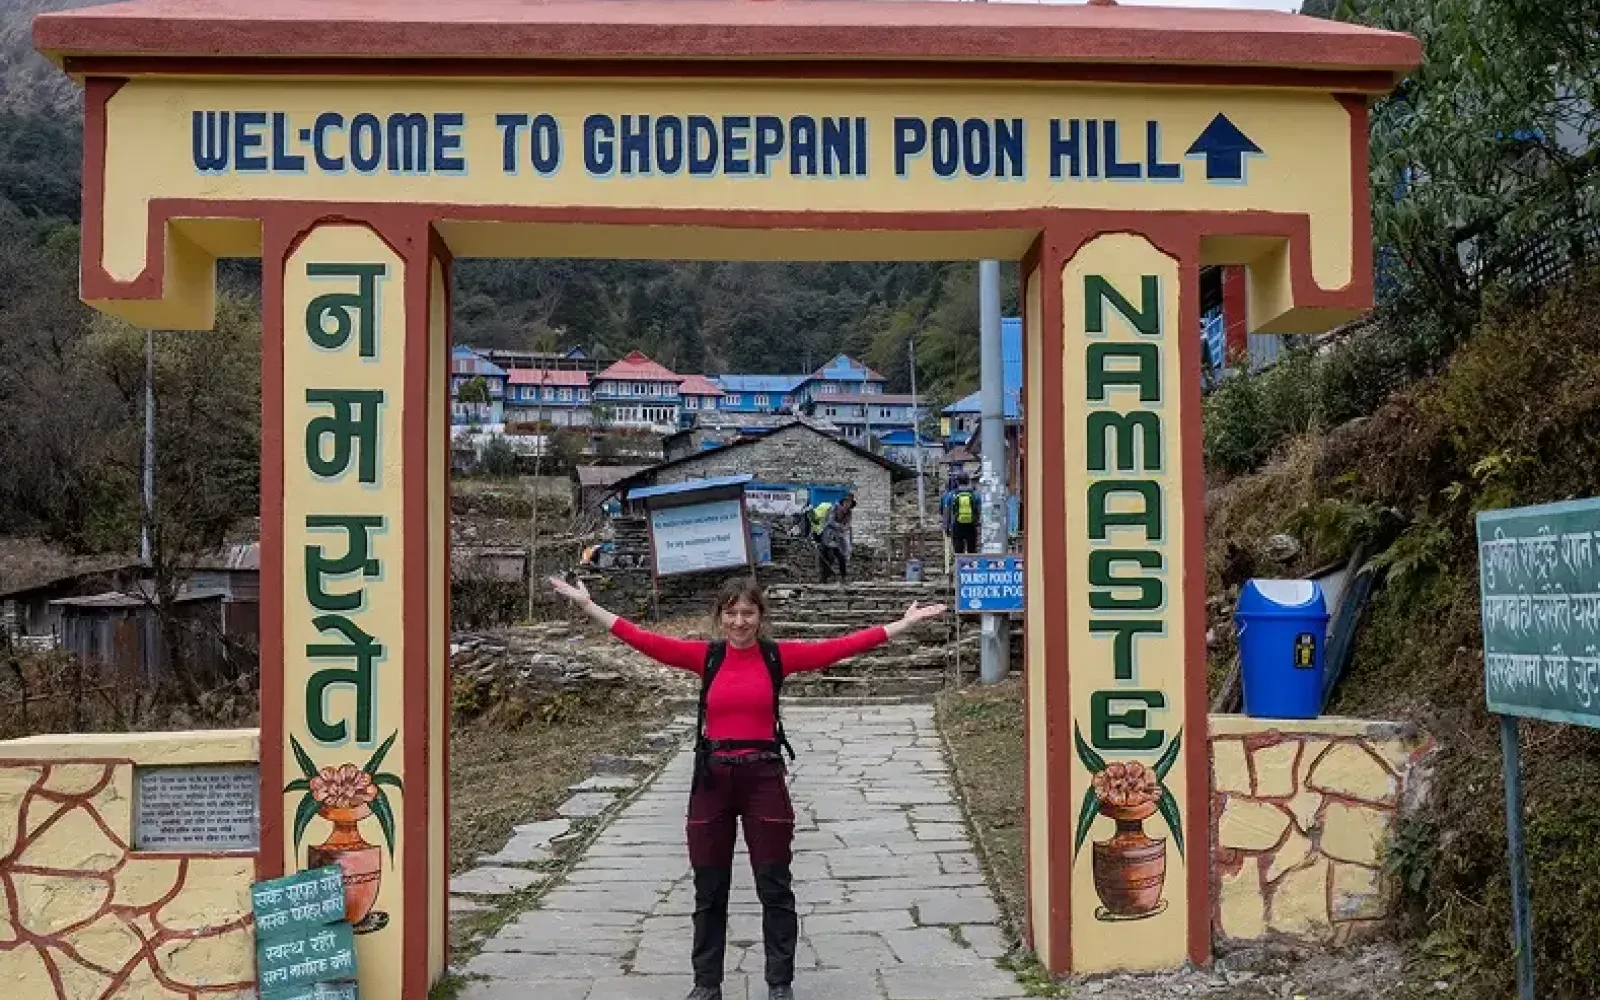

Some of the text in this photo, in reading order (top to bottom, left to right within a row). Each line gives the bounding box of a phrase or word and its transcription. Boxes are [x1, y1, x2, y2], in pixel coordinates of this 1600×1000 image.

[497, 113, 561, 174] TO
[584, 115, 867, 177] GHODEPANI
[894, 117, 1023, 177] POON
[1050, 119, 1181, 179] HILL
[306, 263, 386, 742] नमस्ते
[1085, 275, 1164, 751] NAMASTE
[961, 586, 1000, 599] CHECK
[989, 571, 1012, 585] POLICE
